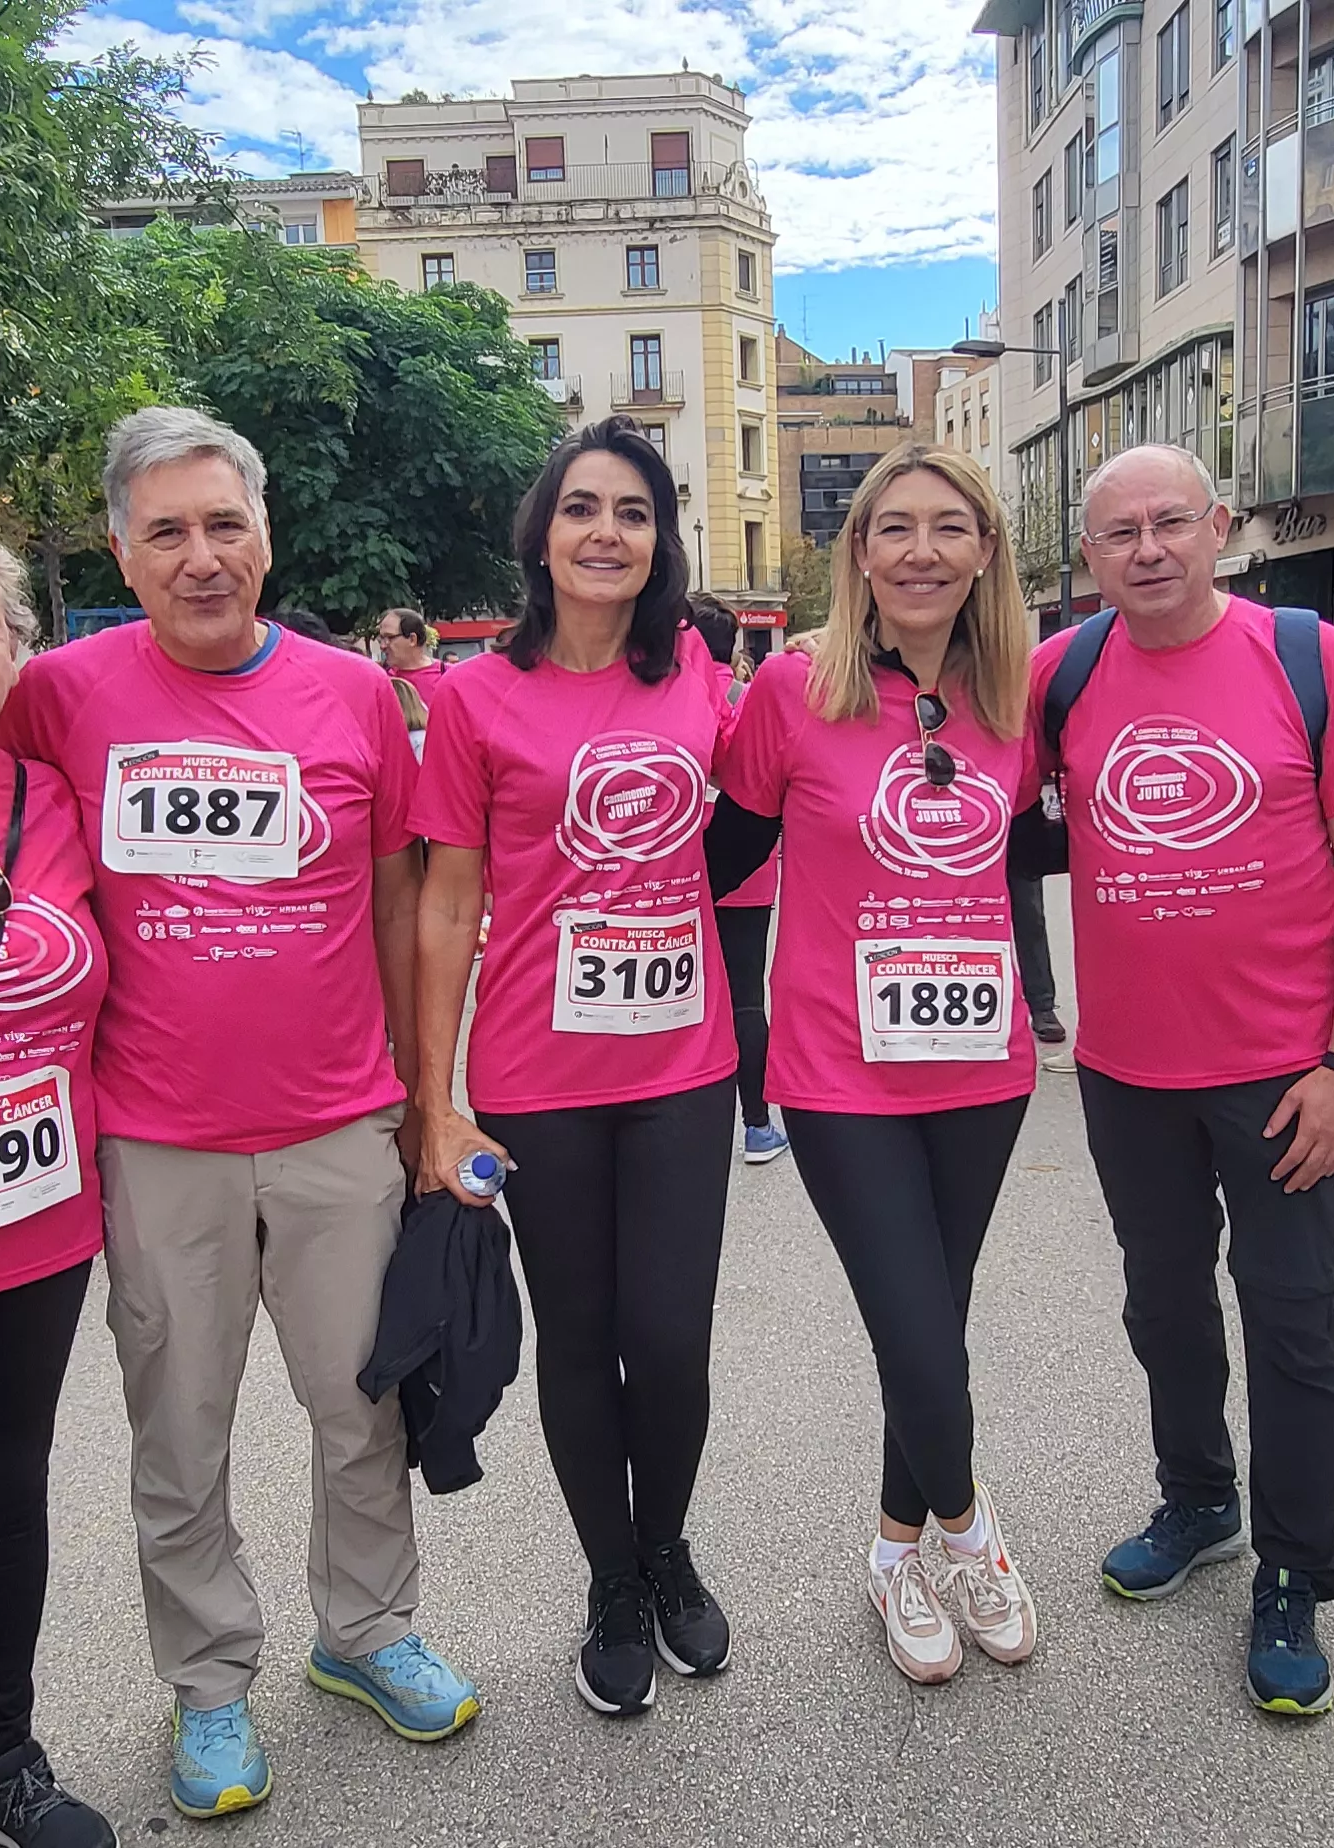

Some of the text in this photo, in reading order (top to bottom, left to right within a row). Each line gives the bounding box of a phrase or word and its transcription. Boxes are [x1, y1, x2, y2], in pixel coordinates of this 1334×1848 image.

[1273, 503, 1327, 545] Bar
[748, 613, 776, 624] Santander
[182, 757, 228, 767] HUESCA
[131, 765, 279, 783] CONTRA EL CÁNCER
[1137, 783, 1184, 801] JUNTOS
[127, 787, 281, 838] 1887
[608, 798, 653, 820] JUNTOS
[916, 810, 962, 823] JUNTOS
[1217, 865, 1246, 875] URBAN
[279, 905, 308, 914] URBAN
[580, 933, 694, 951] CONTRA EL CÁNCER
[627, 930, 665, 939] HUESCA
[921, 953, 958, 963] HUESCA
[574, 952, 694, 1000] 3109
[876, 961, 998, 976] CONTRA EL CÁNCER
[877, 982, 998, 1027] 1889
[2, 1094, 54, 1121] CÁNCER
